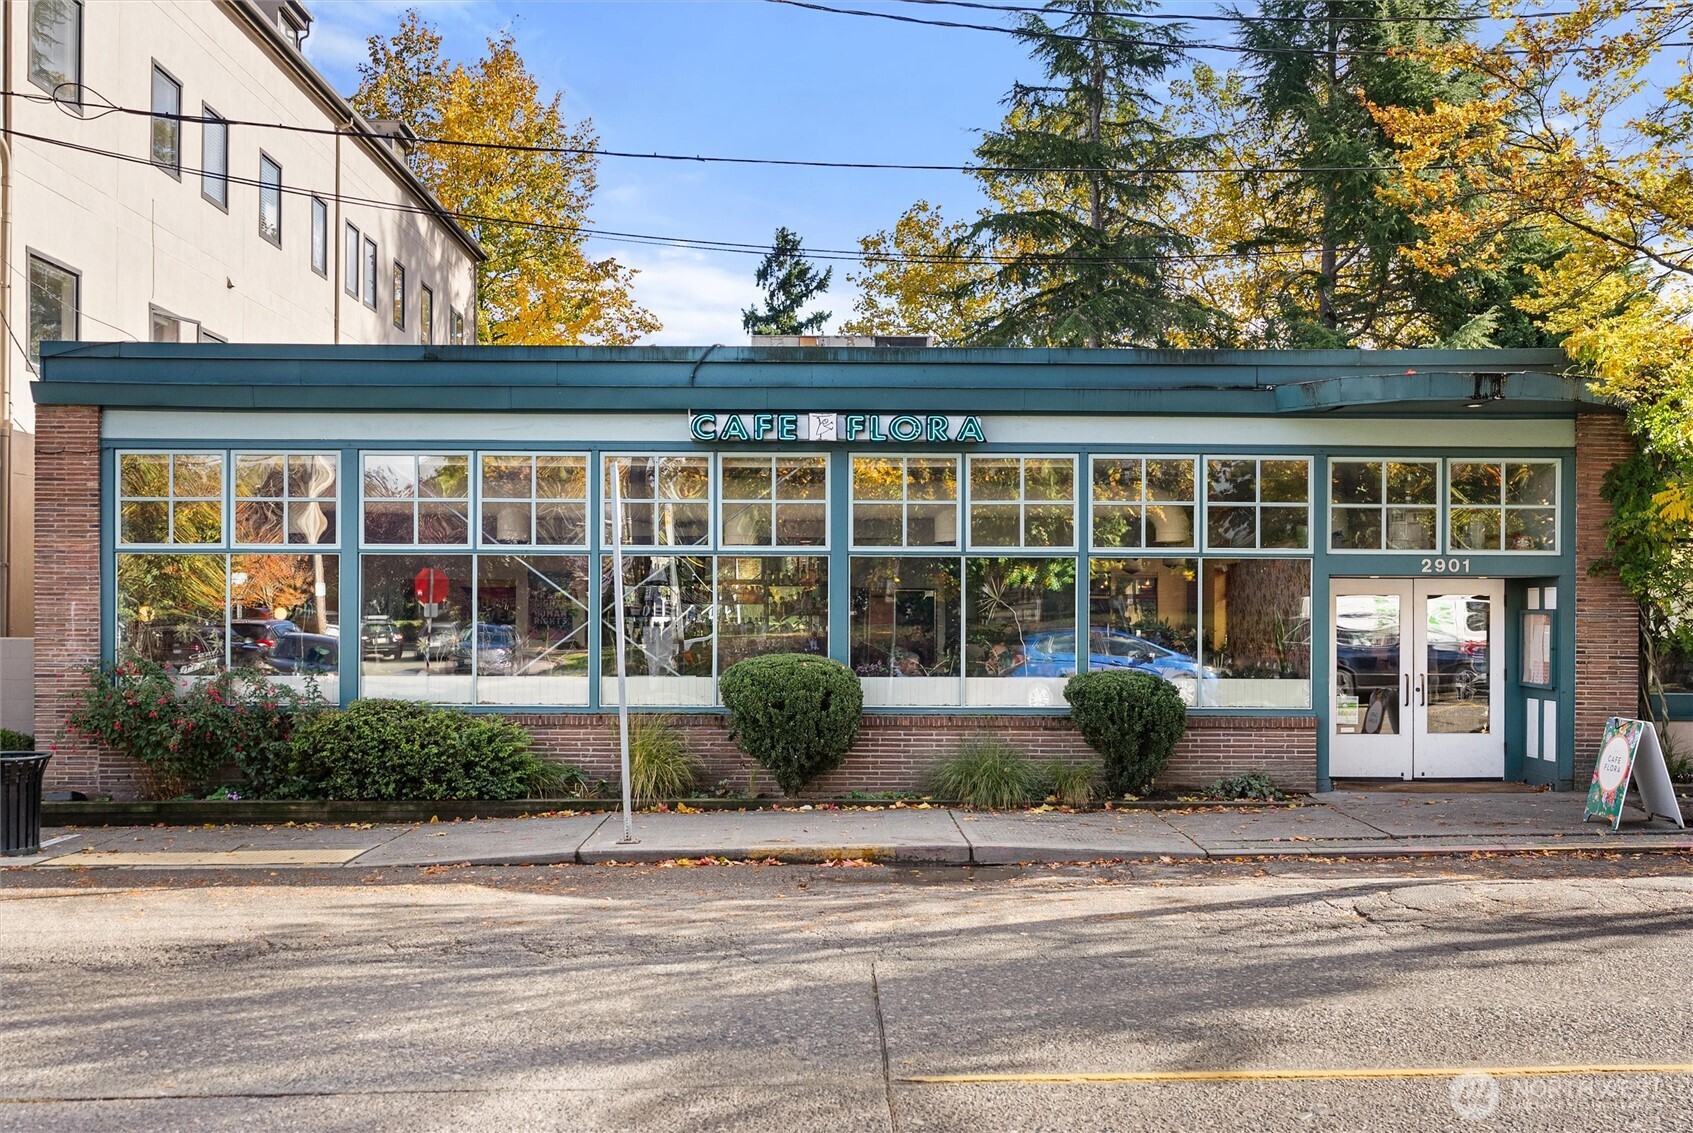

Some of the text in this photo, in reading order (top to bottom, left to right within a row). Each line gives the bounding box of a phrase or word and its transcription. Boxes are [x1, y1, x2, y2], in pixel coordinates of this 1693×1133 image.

[691, 413, 986, 442] CAFE FLORA
[1421, 558, 1470, 573] 2901
[1608, 755, 1621, 764] CAFE
[1604, 764, 1621, 773] FLORA
